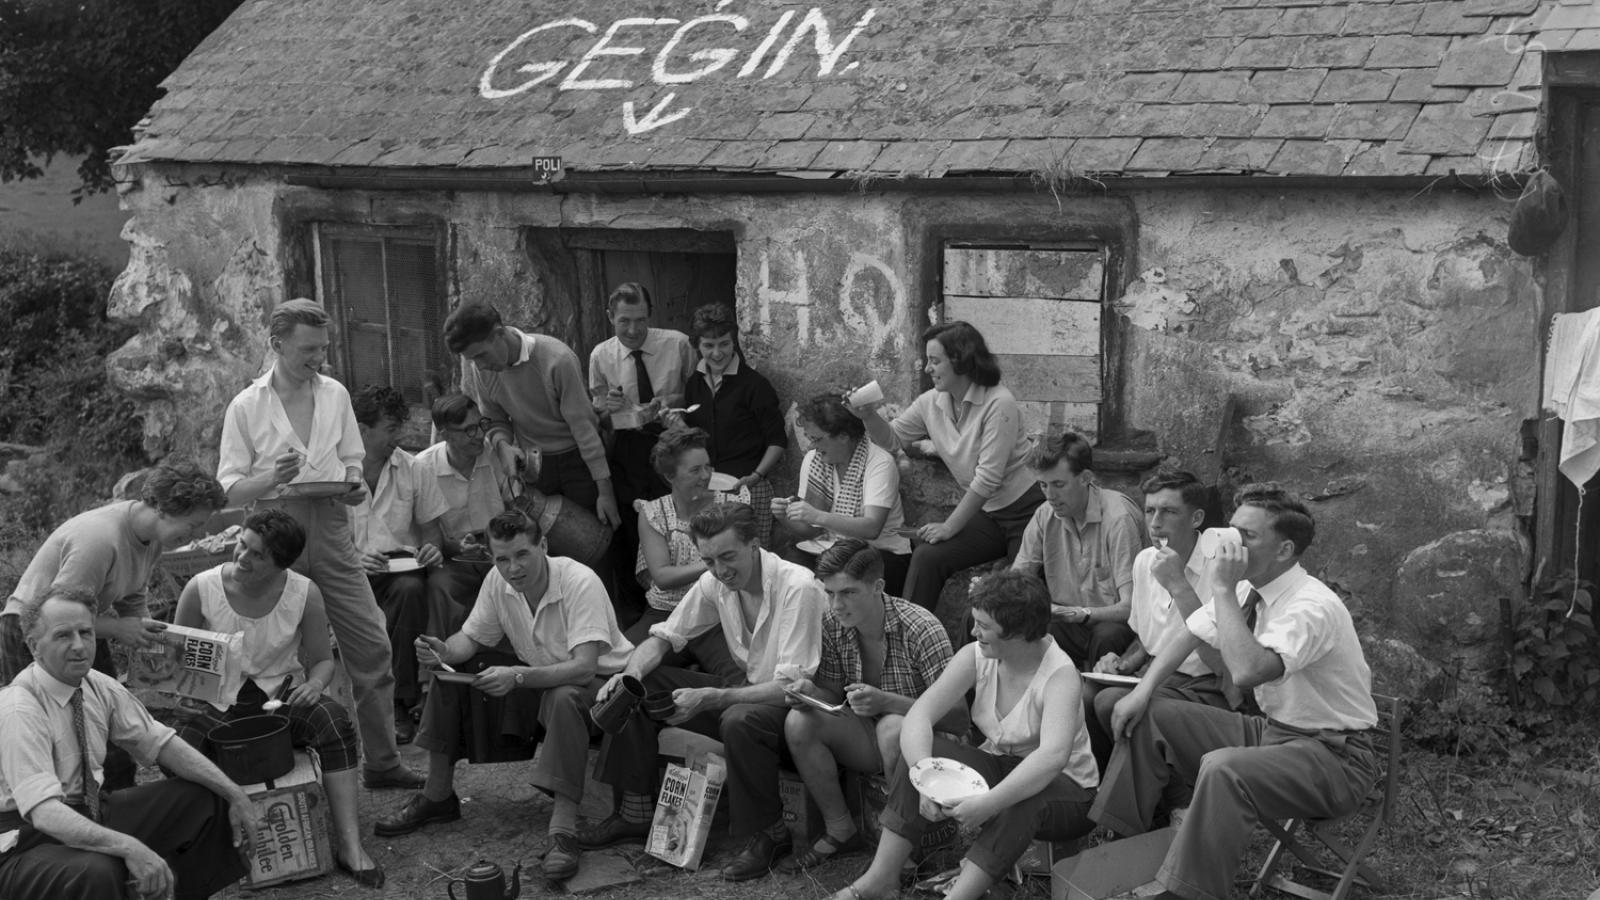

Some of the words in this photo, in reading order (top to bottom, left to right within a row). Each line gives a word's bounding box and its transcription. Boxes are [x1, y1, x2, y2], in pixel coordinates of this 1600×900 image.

[535, 158, 560, 171] POLI
[185, 638, 198, 668] FLAKES
[197, 640, 213, 670] CORN
[660, 791, 682, 805] FLAKES
[664, 777, 687, 797] CORN
[267, 801, 298, 863] Golden
